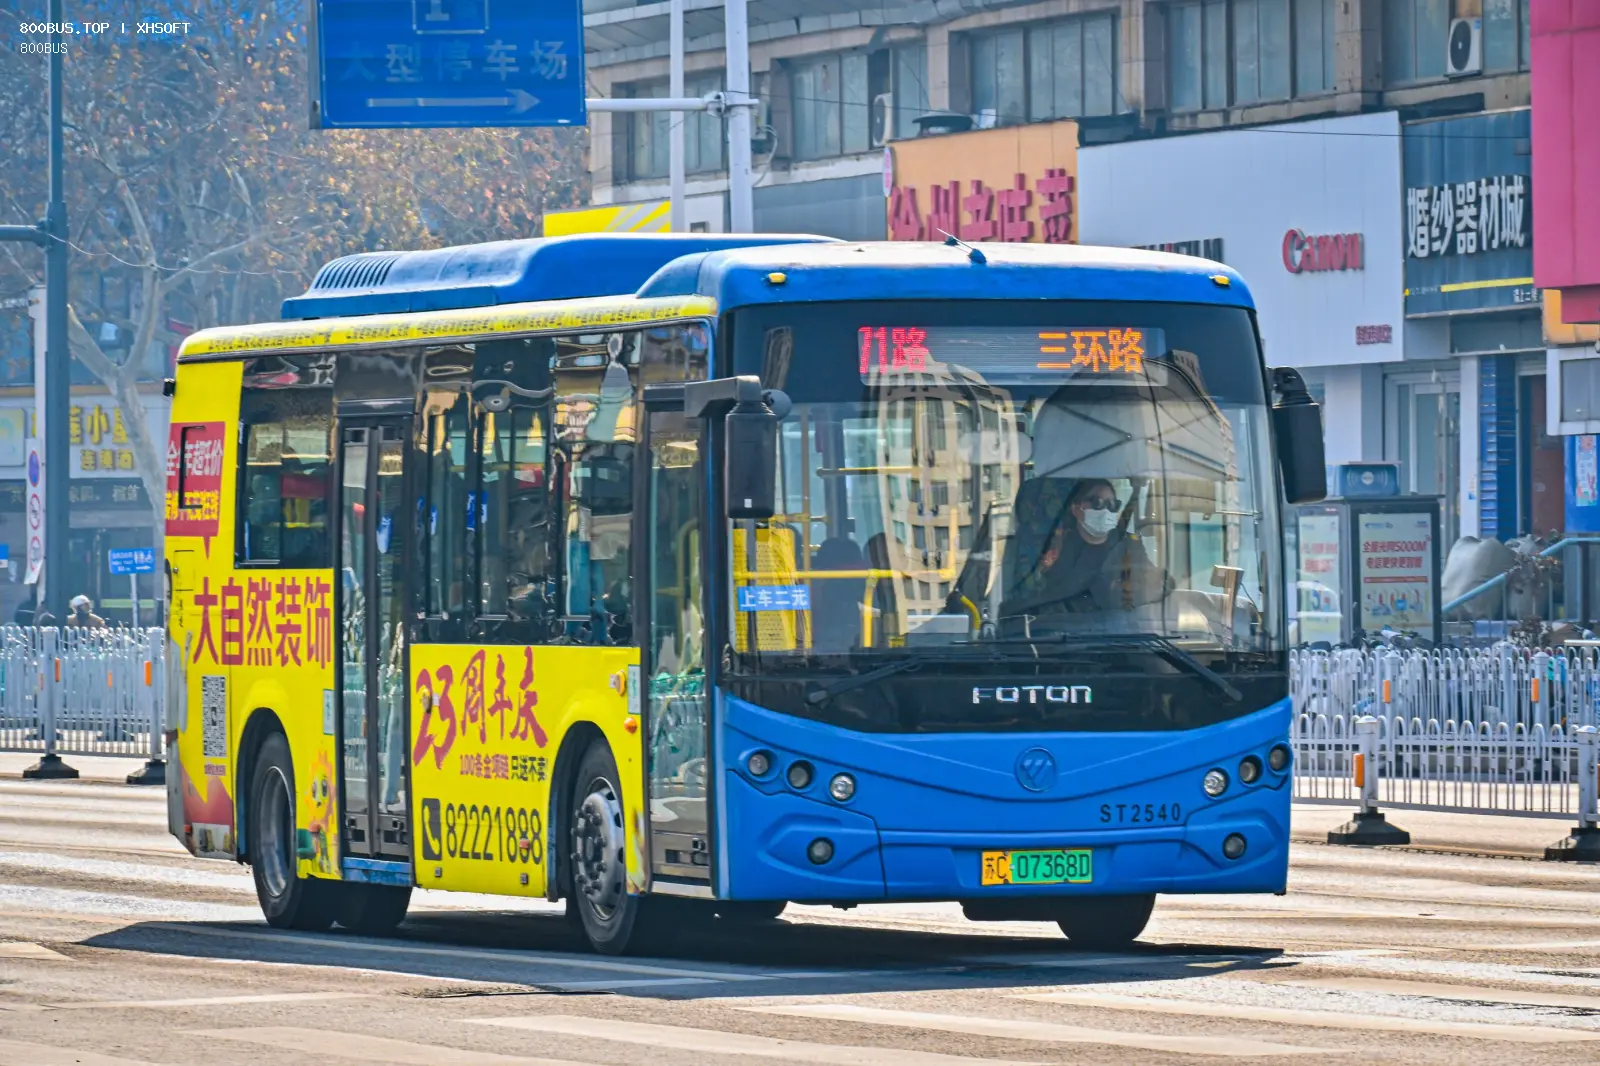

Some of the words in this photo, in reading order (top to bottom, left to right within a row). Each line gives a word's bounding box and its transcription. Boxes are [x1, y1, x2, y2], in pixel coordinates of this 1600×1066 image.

[340, 39, 568, 82] 大型停车场
[1407, 175, 1525, 257] 婚纱器材城
[1283, 228, 1364, 274] Canon
[1037, 328, 1144, 373] 三环路
[740, 589, 809, 607] 上车二元
[193, 577, 331, 669] 大自然装饰
[413, 646, 548, 770] 23周年庆
[972, 686, 1092, 704] FOTON
[446, 803, 543, 865] 82221888
[1100, 803, 1181, 823] ST2540
